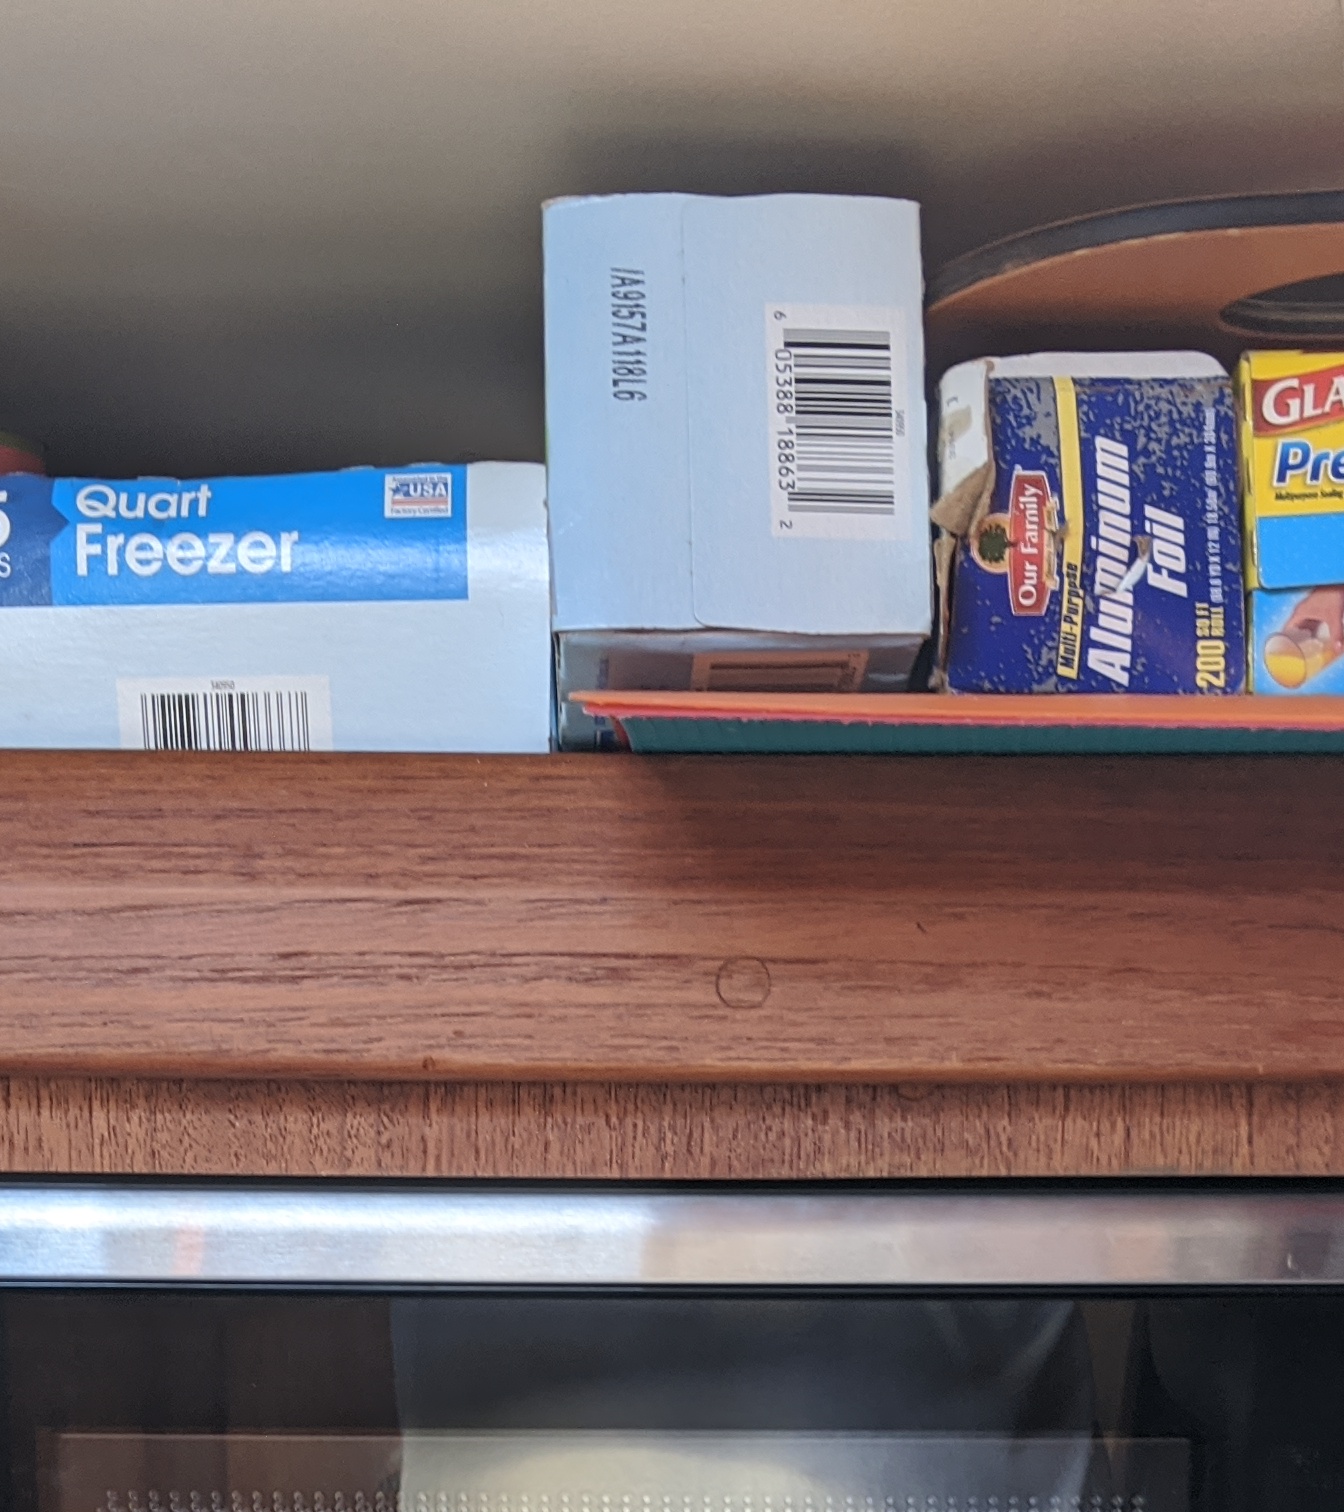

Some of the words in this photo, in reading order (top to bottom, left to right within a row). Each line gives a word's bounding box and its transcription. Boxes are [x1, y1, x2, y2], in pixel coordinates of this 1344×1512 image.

[773, 310, 787, 321] 6
[775, 348, 794, 415] 05388
[776, 427, 796, 491] 18863
[76, 484, 211, 520] Quart
[409, 482, 448, 497] USA
[779, 519, 793, 530] 2
[1018, 484, 1044, 555] Family
[76, 523, 300, 577] Freezer
[1144, 504, 1189, 598] Foil
[1018, 560, 1039, 607] Our
[1058, 561, 1084, 670] Multi-Purpose
[1195, 639, 1226, 689] 200
